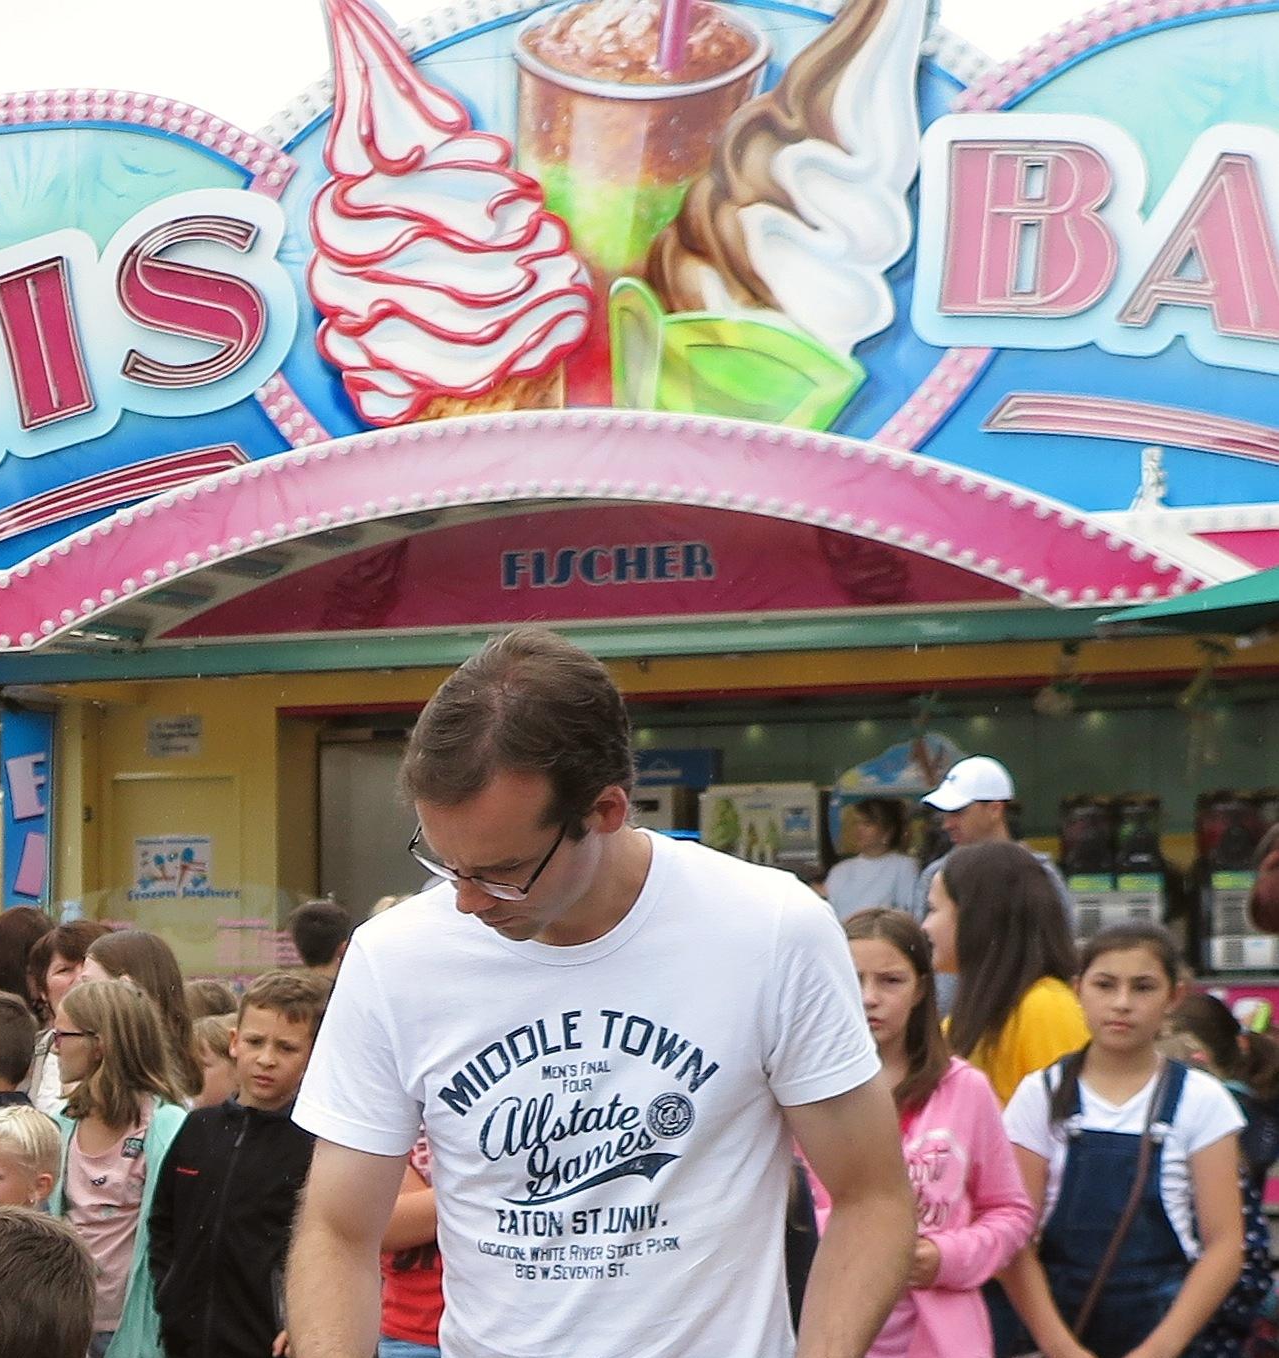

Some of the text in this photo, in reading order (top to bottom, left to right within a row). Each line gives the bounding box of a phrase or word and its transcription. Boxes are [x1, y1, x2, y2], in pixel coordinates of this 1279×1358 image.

[501, 541, 714, 589] FISCHER
[437, 1010, 582, 1117] MIDDLE
[600, 1010, 720, 1093] TOWN
[580, 1059, 612, 1077] FINAL
[562, 1078, 592, 1094] FOUR
[478, 1092, 641, 1161] Allstate
[526, 1126, 657, 1200] Games
[496, 1208, 564, 1237] EATON
[530, 1245, 566, 1262] WHITE
[606, 1242, 642, 1259] STATE
